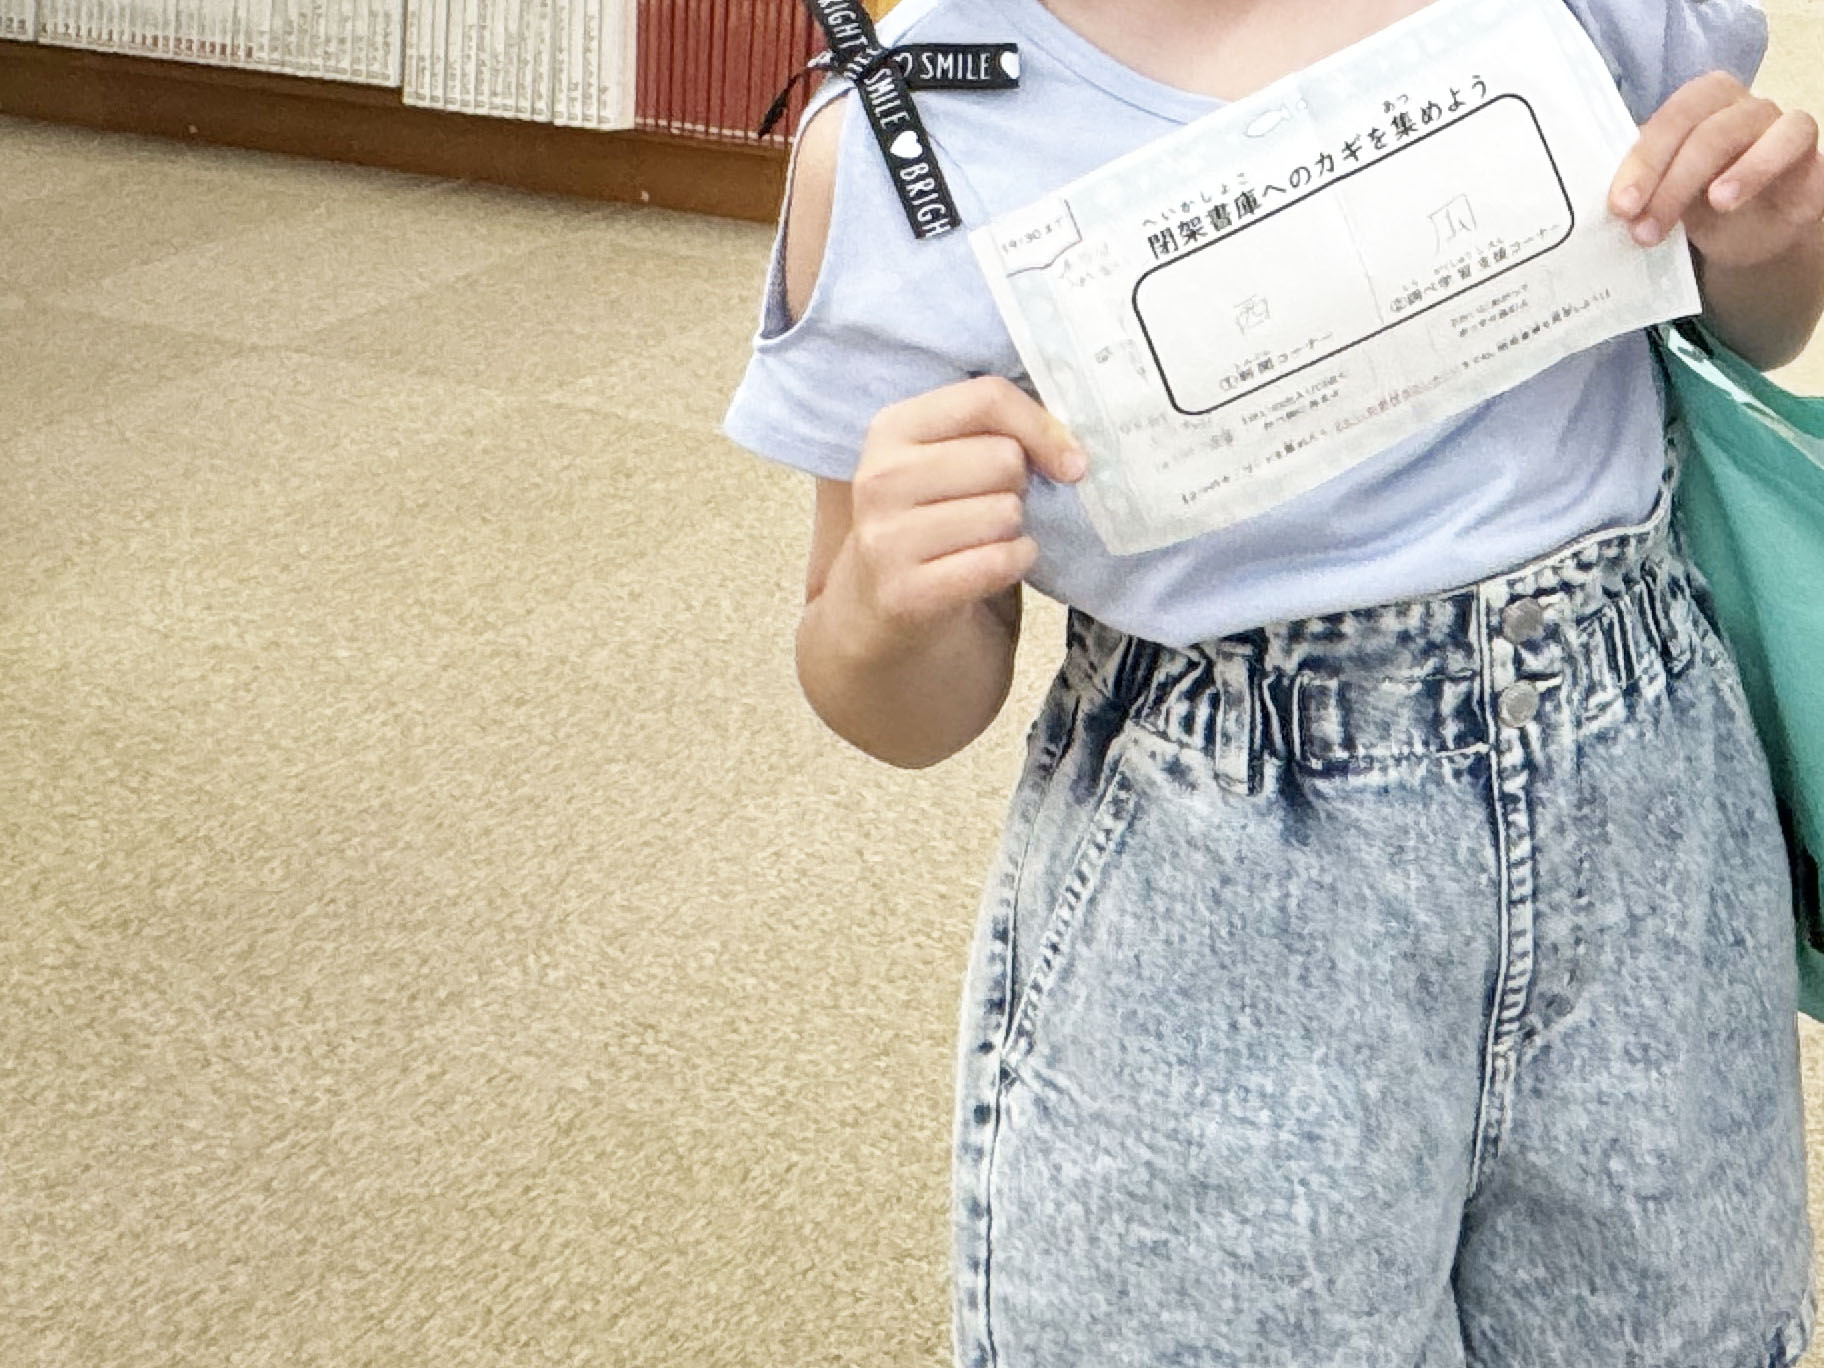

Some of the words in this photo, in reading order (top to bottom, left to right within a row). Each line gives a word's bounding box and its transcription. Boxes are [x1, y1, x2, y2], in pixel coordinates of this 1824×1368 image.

[919, 52, 991, 80] SMILE
[864, 67, 911, 130] SMILE
[1146, 73, 1490, 260] 閉架書庫へのカギを集めよう
